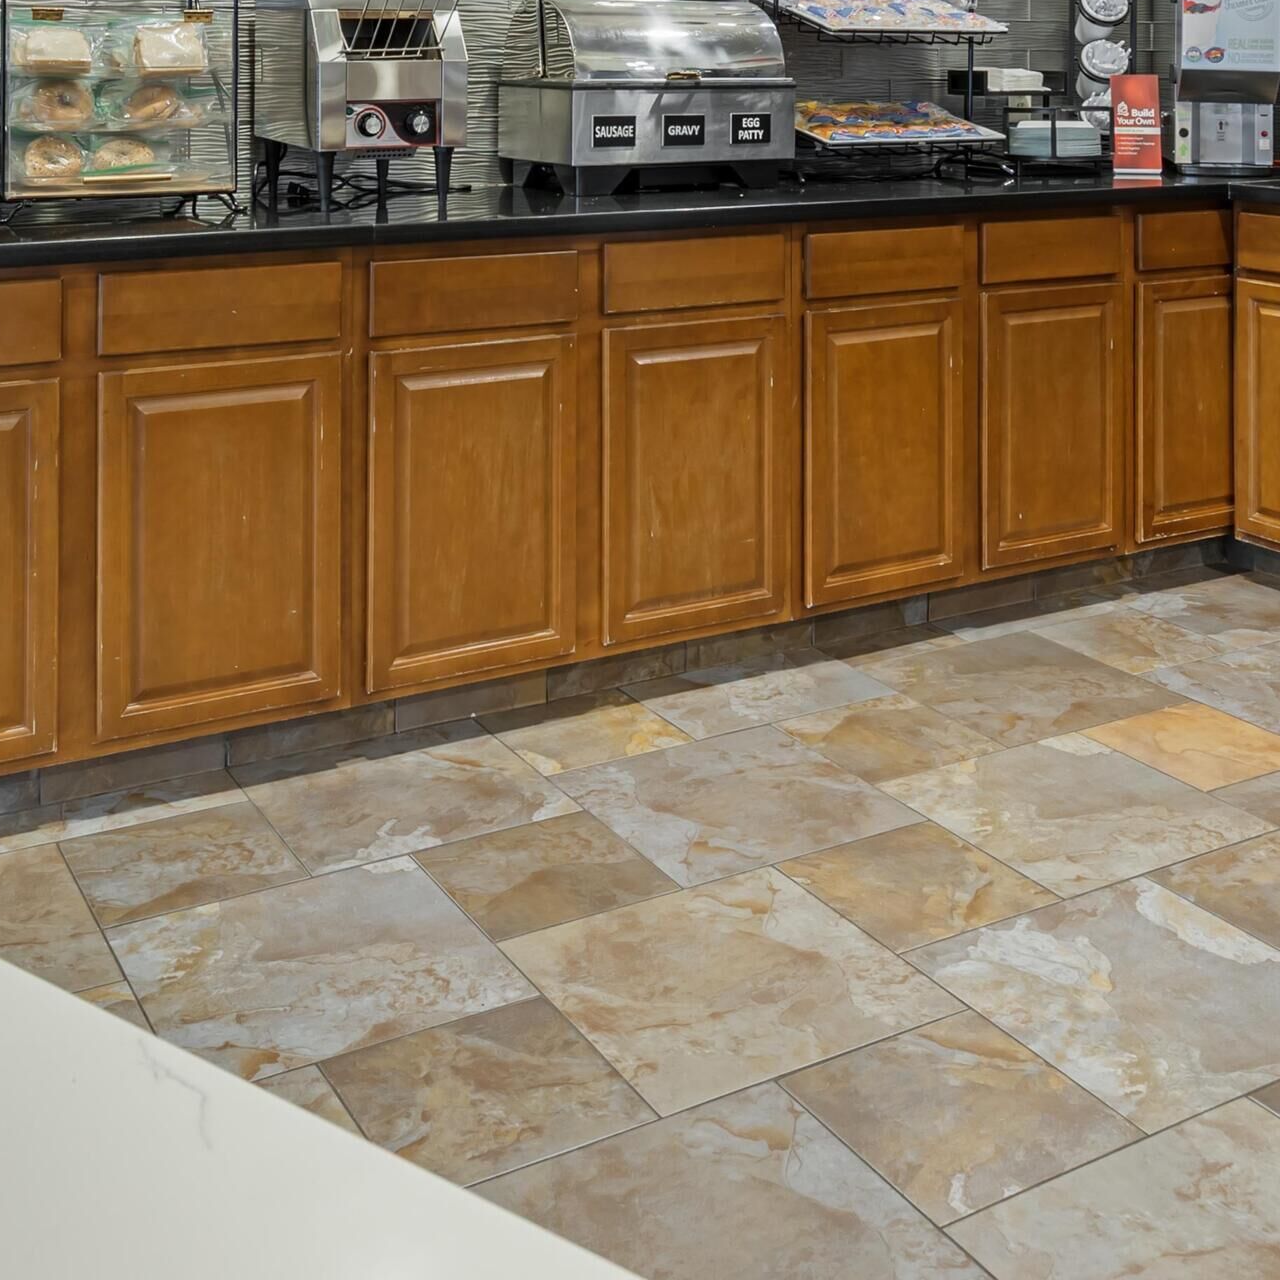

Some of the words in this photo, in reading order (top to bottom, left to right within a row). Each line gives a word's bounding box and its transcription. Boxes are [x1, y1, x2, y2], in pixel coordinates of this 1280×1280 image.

[1131, 108, 1155, 118] Build
[742, 117, 760, 128] EGG
[1116, 116, 1135, 125] Your
[1135, 117, 1156, 126] Own
[595, 125, 635, 138] SAUSAGE
[667, 125, 700, 136] GRAVY
[738, 129, 764, 140] PATTY
